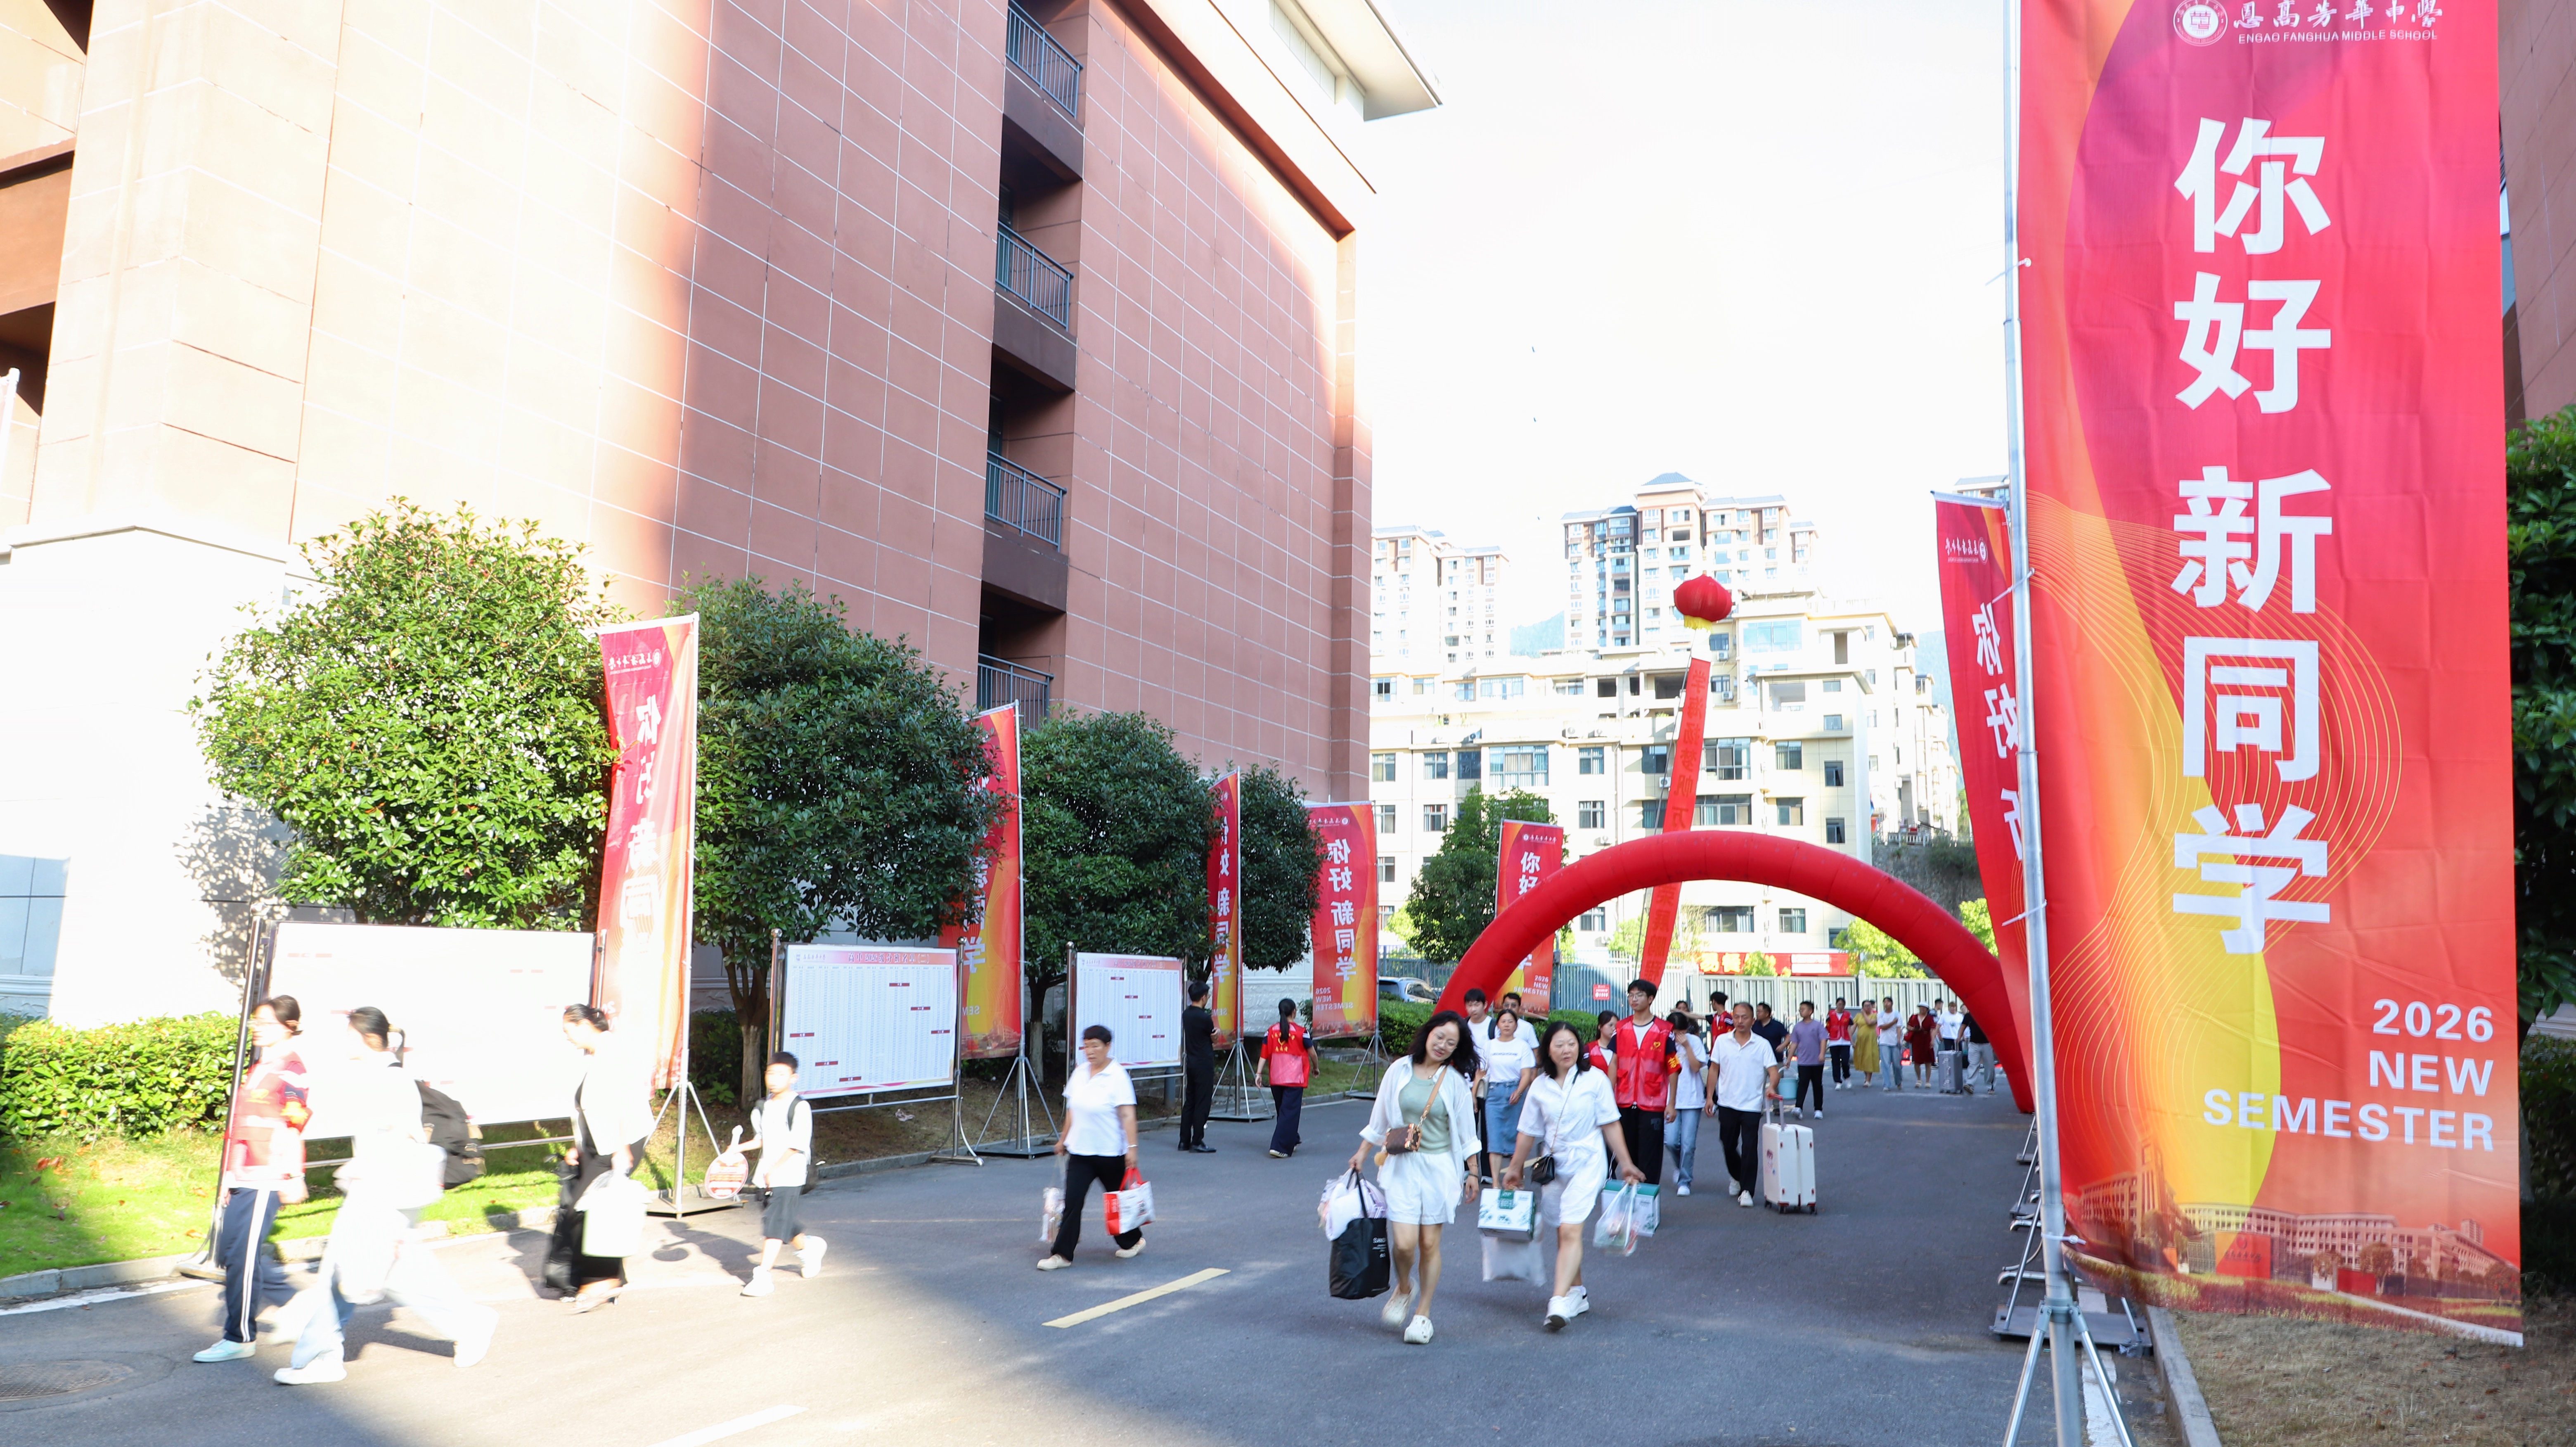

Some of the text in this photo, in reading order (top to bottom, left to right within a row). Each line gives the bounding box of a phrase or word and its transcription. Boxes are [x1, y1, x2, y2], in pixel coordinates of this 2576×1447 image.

[2239, 29, 2437, 44] ENGAO FANGHUA MIDDLE SCHOOL
[2171, 117, 2332, 955] 你好 新同学
[1513, 986, 1548, 996] SEMESTER
[2372, 998, 2494, 1042] 2026
[2369, 1049, 2494, 1097] NEW
[2203, 1088, 2495, 1152] SEMESTER
